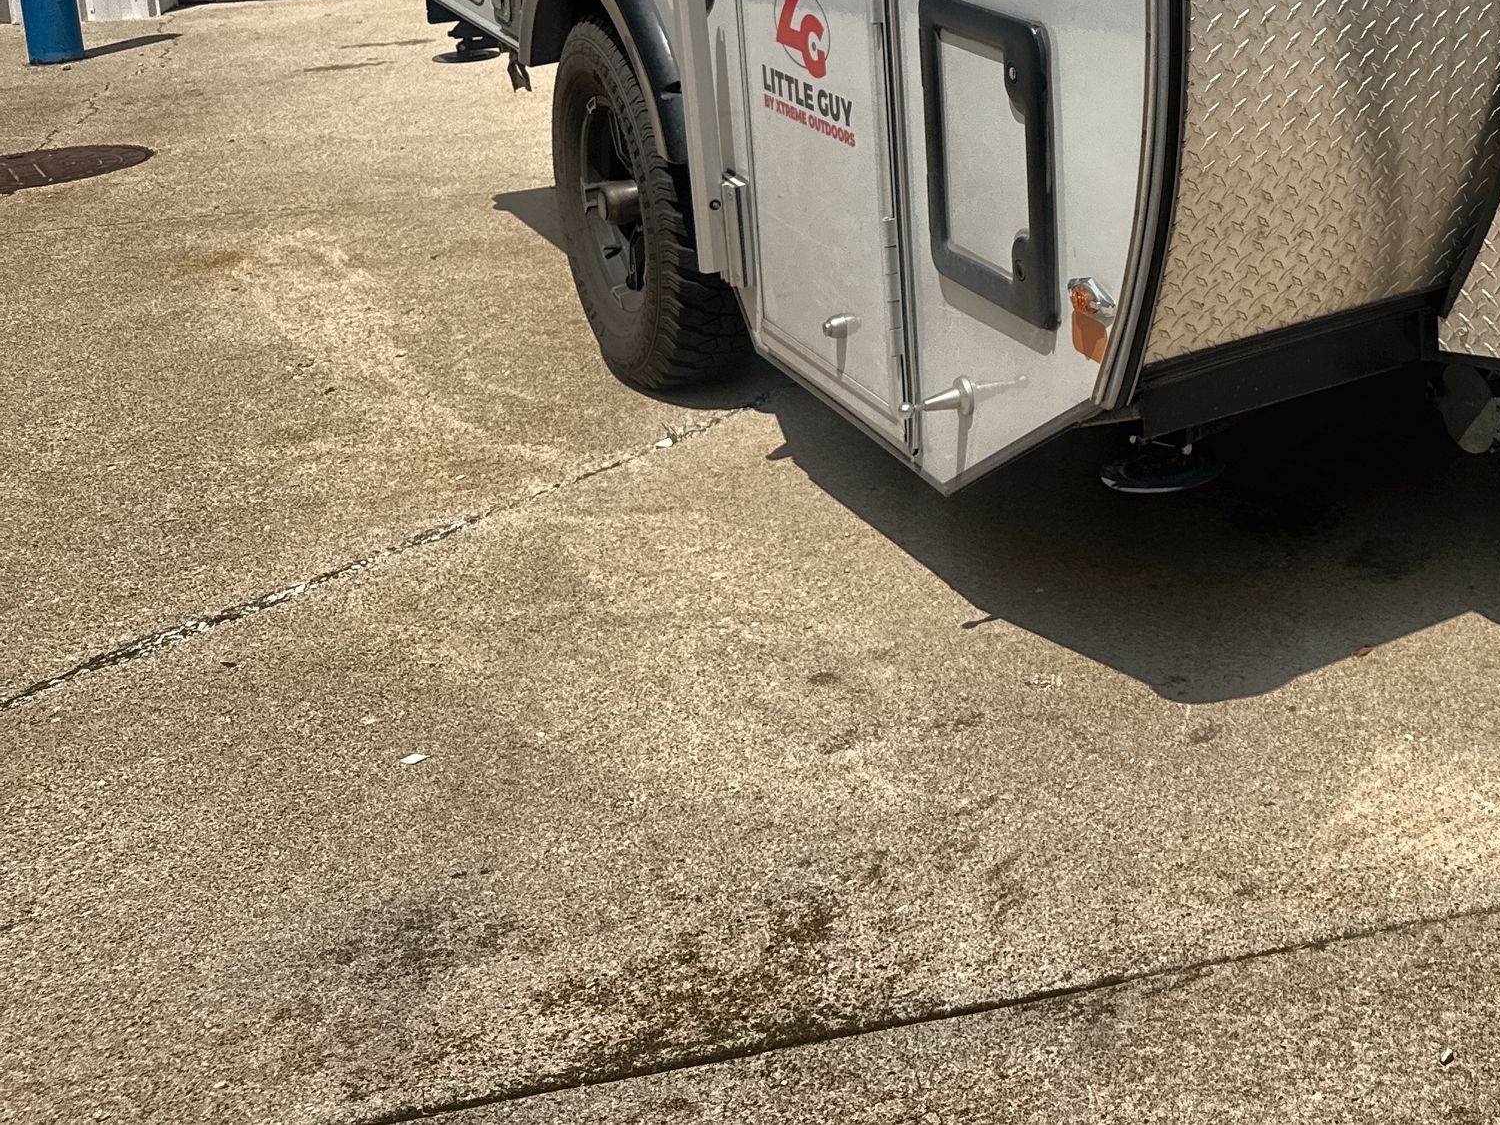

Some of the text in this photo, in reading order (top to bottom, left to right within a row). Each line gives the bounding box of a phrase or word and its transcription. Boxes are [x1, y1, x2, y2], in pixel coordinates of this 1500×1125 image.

[762, 64, 852, 126] LITTLE GUY
[764, 93, 855, 147] BY XTREME OUTDOORS
